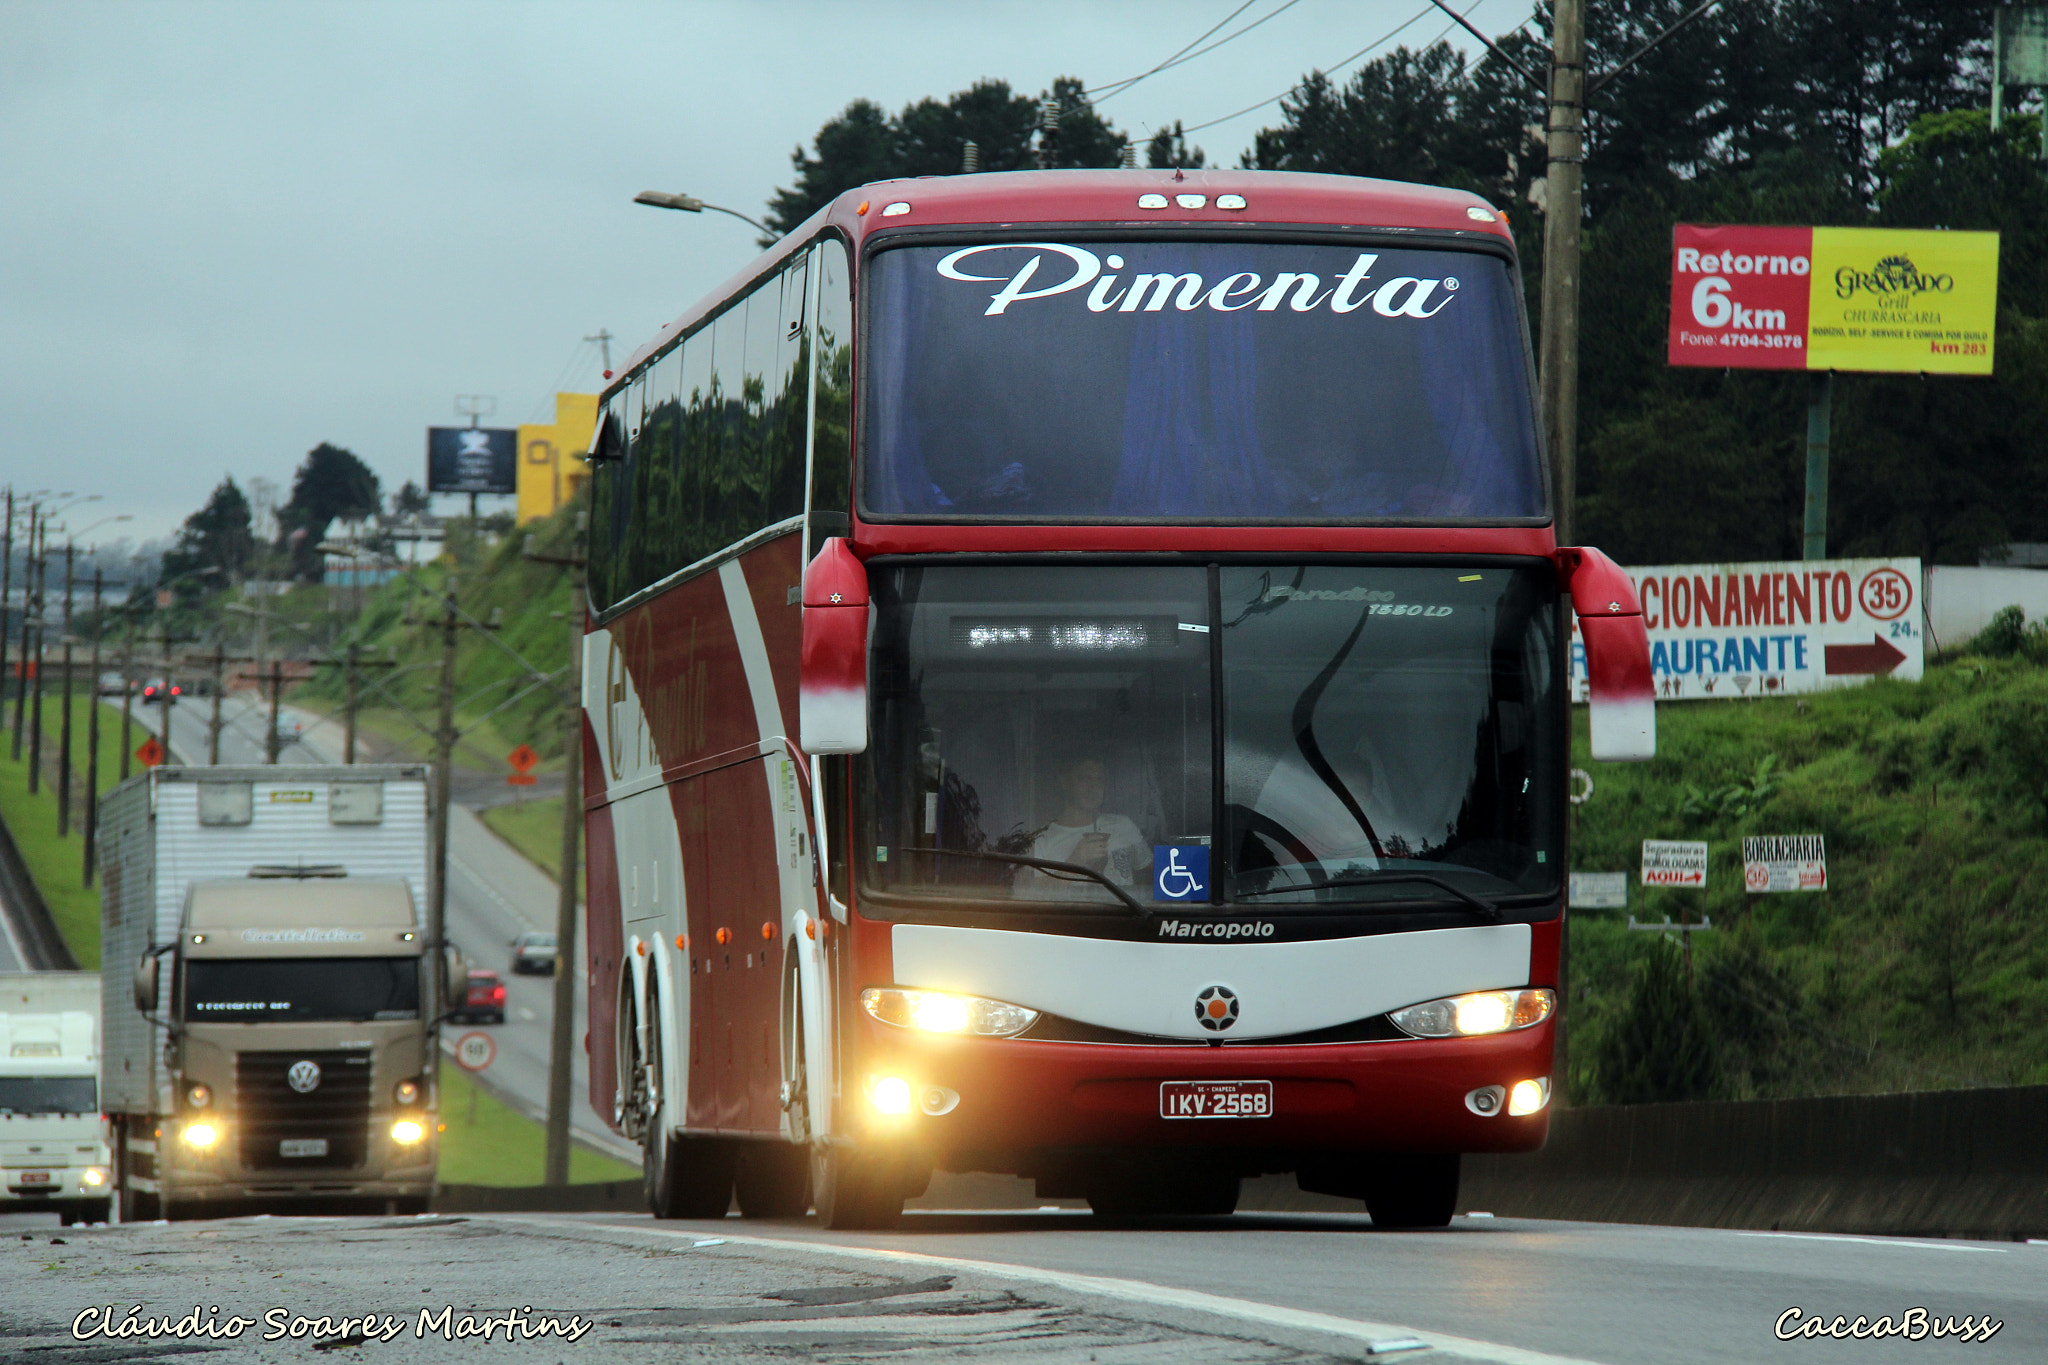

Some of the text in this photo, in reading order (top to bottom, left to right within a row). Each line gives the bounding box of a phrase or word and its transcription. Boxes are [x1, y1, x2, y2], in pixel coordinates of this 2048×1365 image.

[1678, 247, 1810, 276] Retorno
[1878, 294, 1909, 309] Grill
[1843, 309, 1941, 324] CHURRASCARIA
[1680, 331, 1717, 346] Fone:
[1931, 339, 1960, 354] km
[1637, 570, 1902, 630] CIONAMENTO 35
[1423, 605, 1454, 618] LD
[1890, 620, 1911, 638] 24
[1571, 634, 1808, 677] RAURANTE
[1744, 835, 1824, 863] BORRACHARIA
[1646, 869, 1684, 884] AQUI
[1159, 920, 1275, 939] Marcopolo
